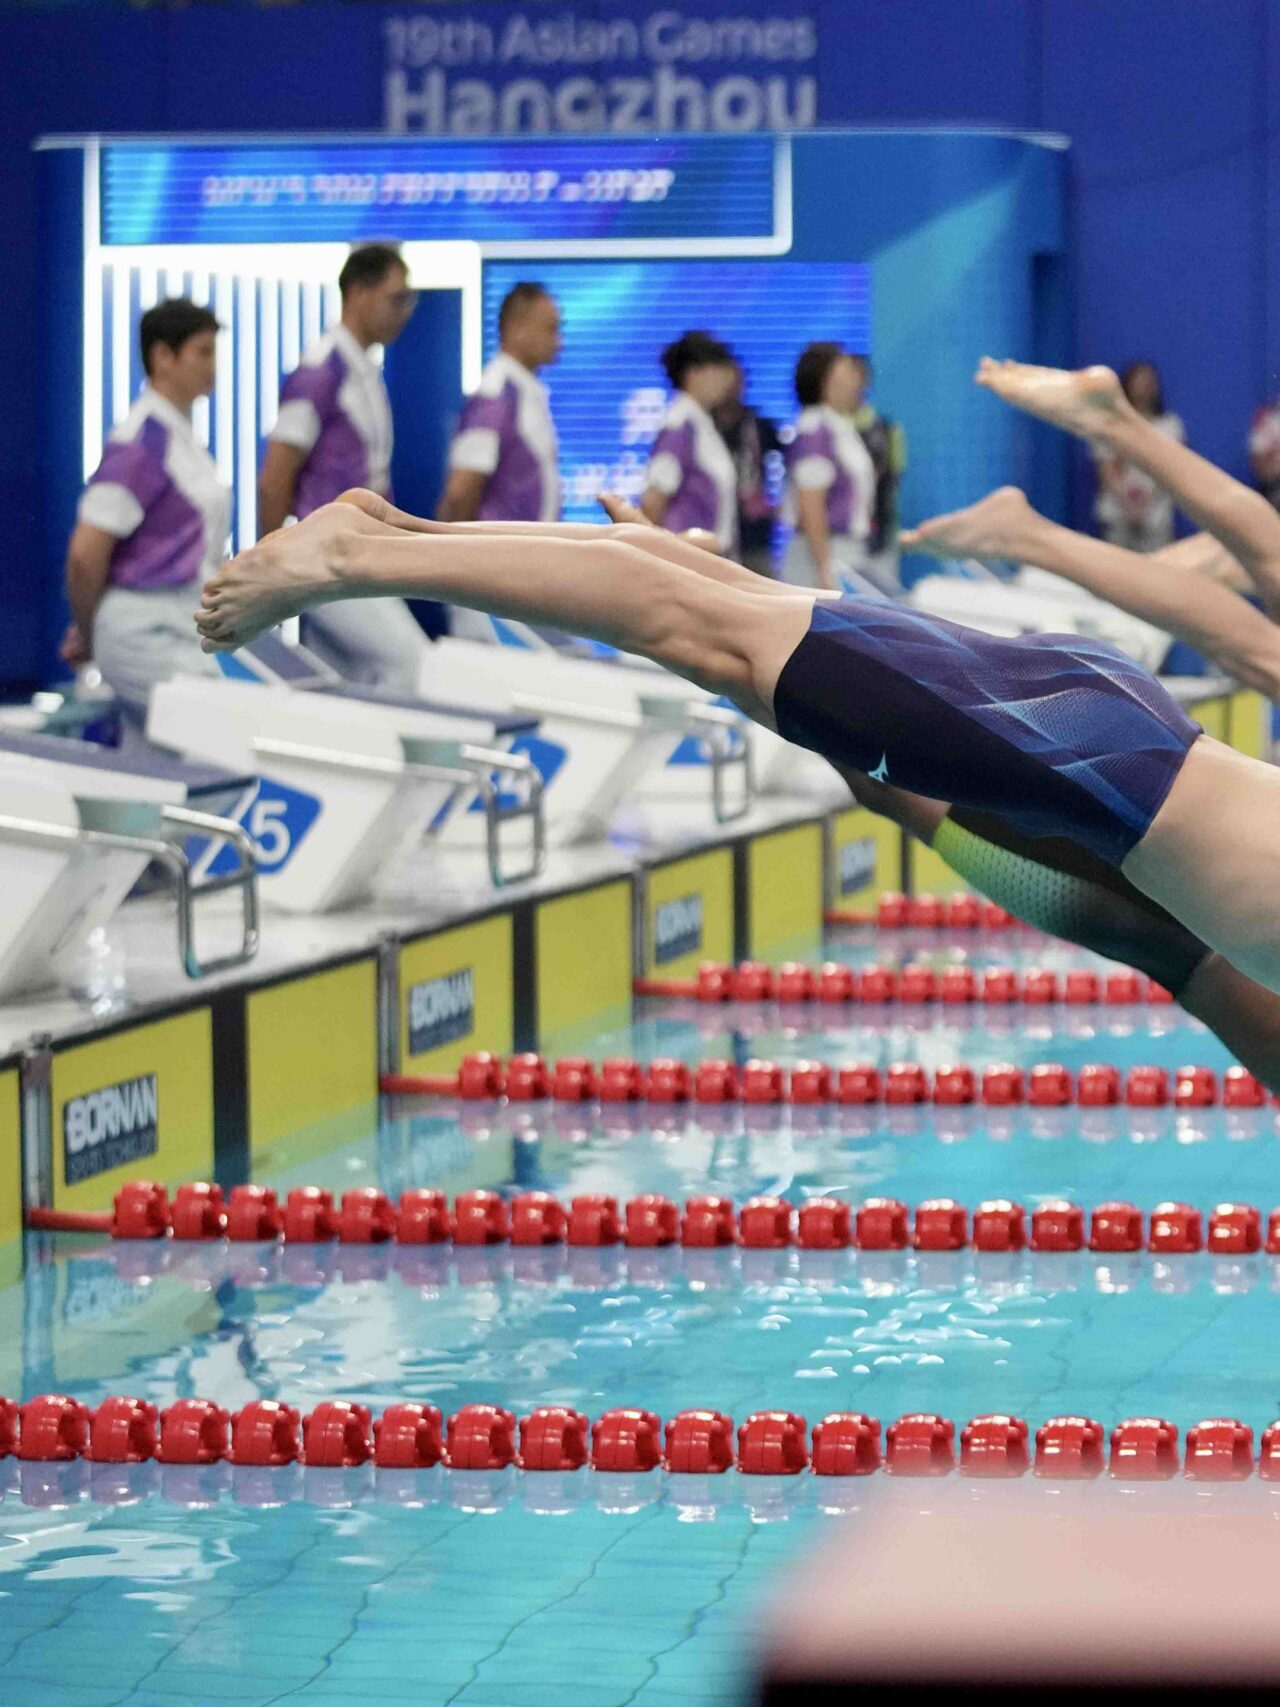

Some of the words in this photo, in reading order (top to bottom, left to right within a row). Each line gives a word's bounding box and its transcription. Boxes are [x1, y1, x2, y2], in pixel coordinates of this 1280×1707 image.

[386, 18, 494, 63] 19th
[502, 15, 639, 61] Asian
[644, 11, 817, 61] Games
[387, 65, 818, 133] Hangzhou
[251, 800, 291, 865] 5
[66, 1074, 158, 1155] BORNAN
